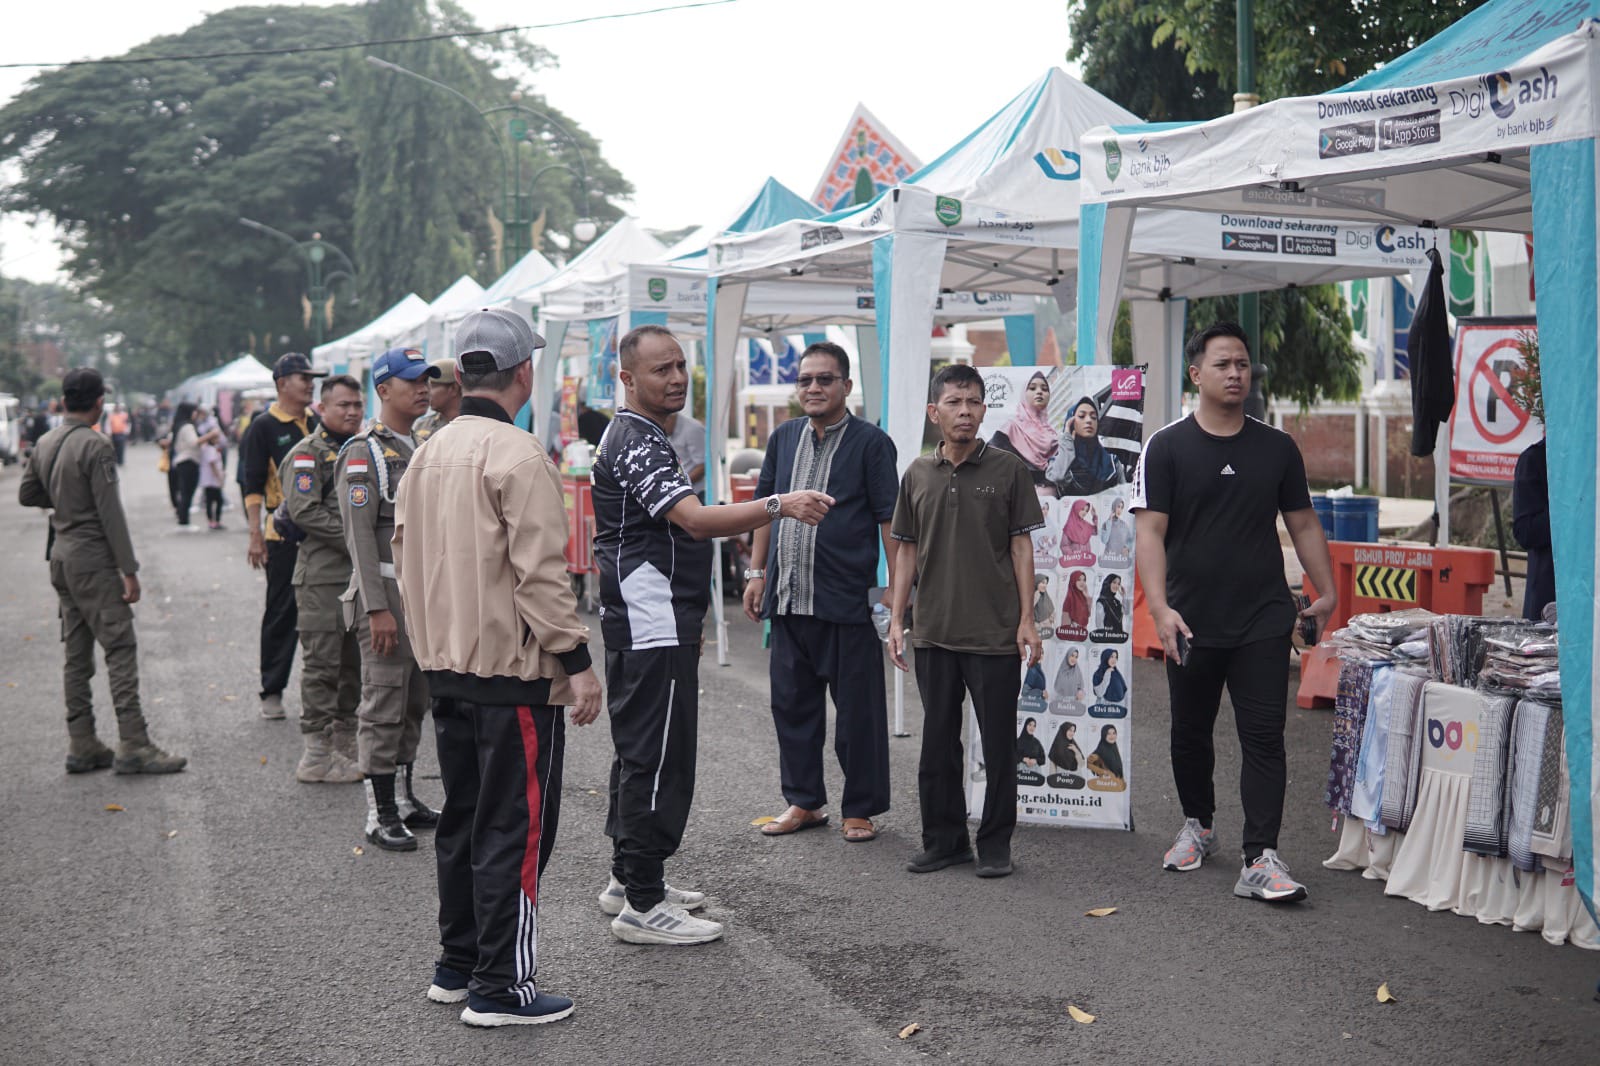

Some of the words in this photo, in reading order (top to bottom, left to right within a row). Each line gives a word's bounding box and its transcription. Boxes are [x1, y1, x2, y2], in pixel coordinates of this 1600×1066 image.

[1318, 93, 1376, 119] Download
[1377, 86, 1438, 109] sekarang
[1394, 128, 1412, 145] App
[1412, 125, 1435, 141] Store
[1497, 127, 1506, 138] by
[1507, 122, 1527, 136] bank
[1529, 118, 1545, 134] bjb
[1335, 137, 1357, 151] Google
[1358, 135, 1372, 149] Play
[1130, 156, 1151, 176] bank
[1153, 153, 1171, 176] bjb
[1221, 214, 1282, 229] Download
[1284, 219, 1338, 236] sekarang
[1238, 240, 1260, 251] Google
[1261, 241, 1276, 251] Play
[1295, 241, 1311, 253] App
[1311, 244, 1332, 254] Store
[1354, 548, 1383, 564] DISHUB
[1384, 550, 1406, 565] PROV
[1056, 776, 1075, 785] Pony
